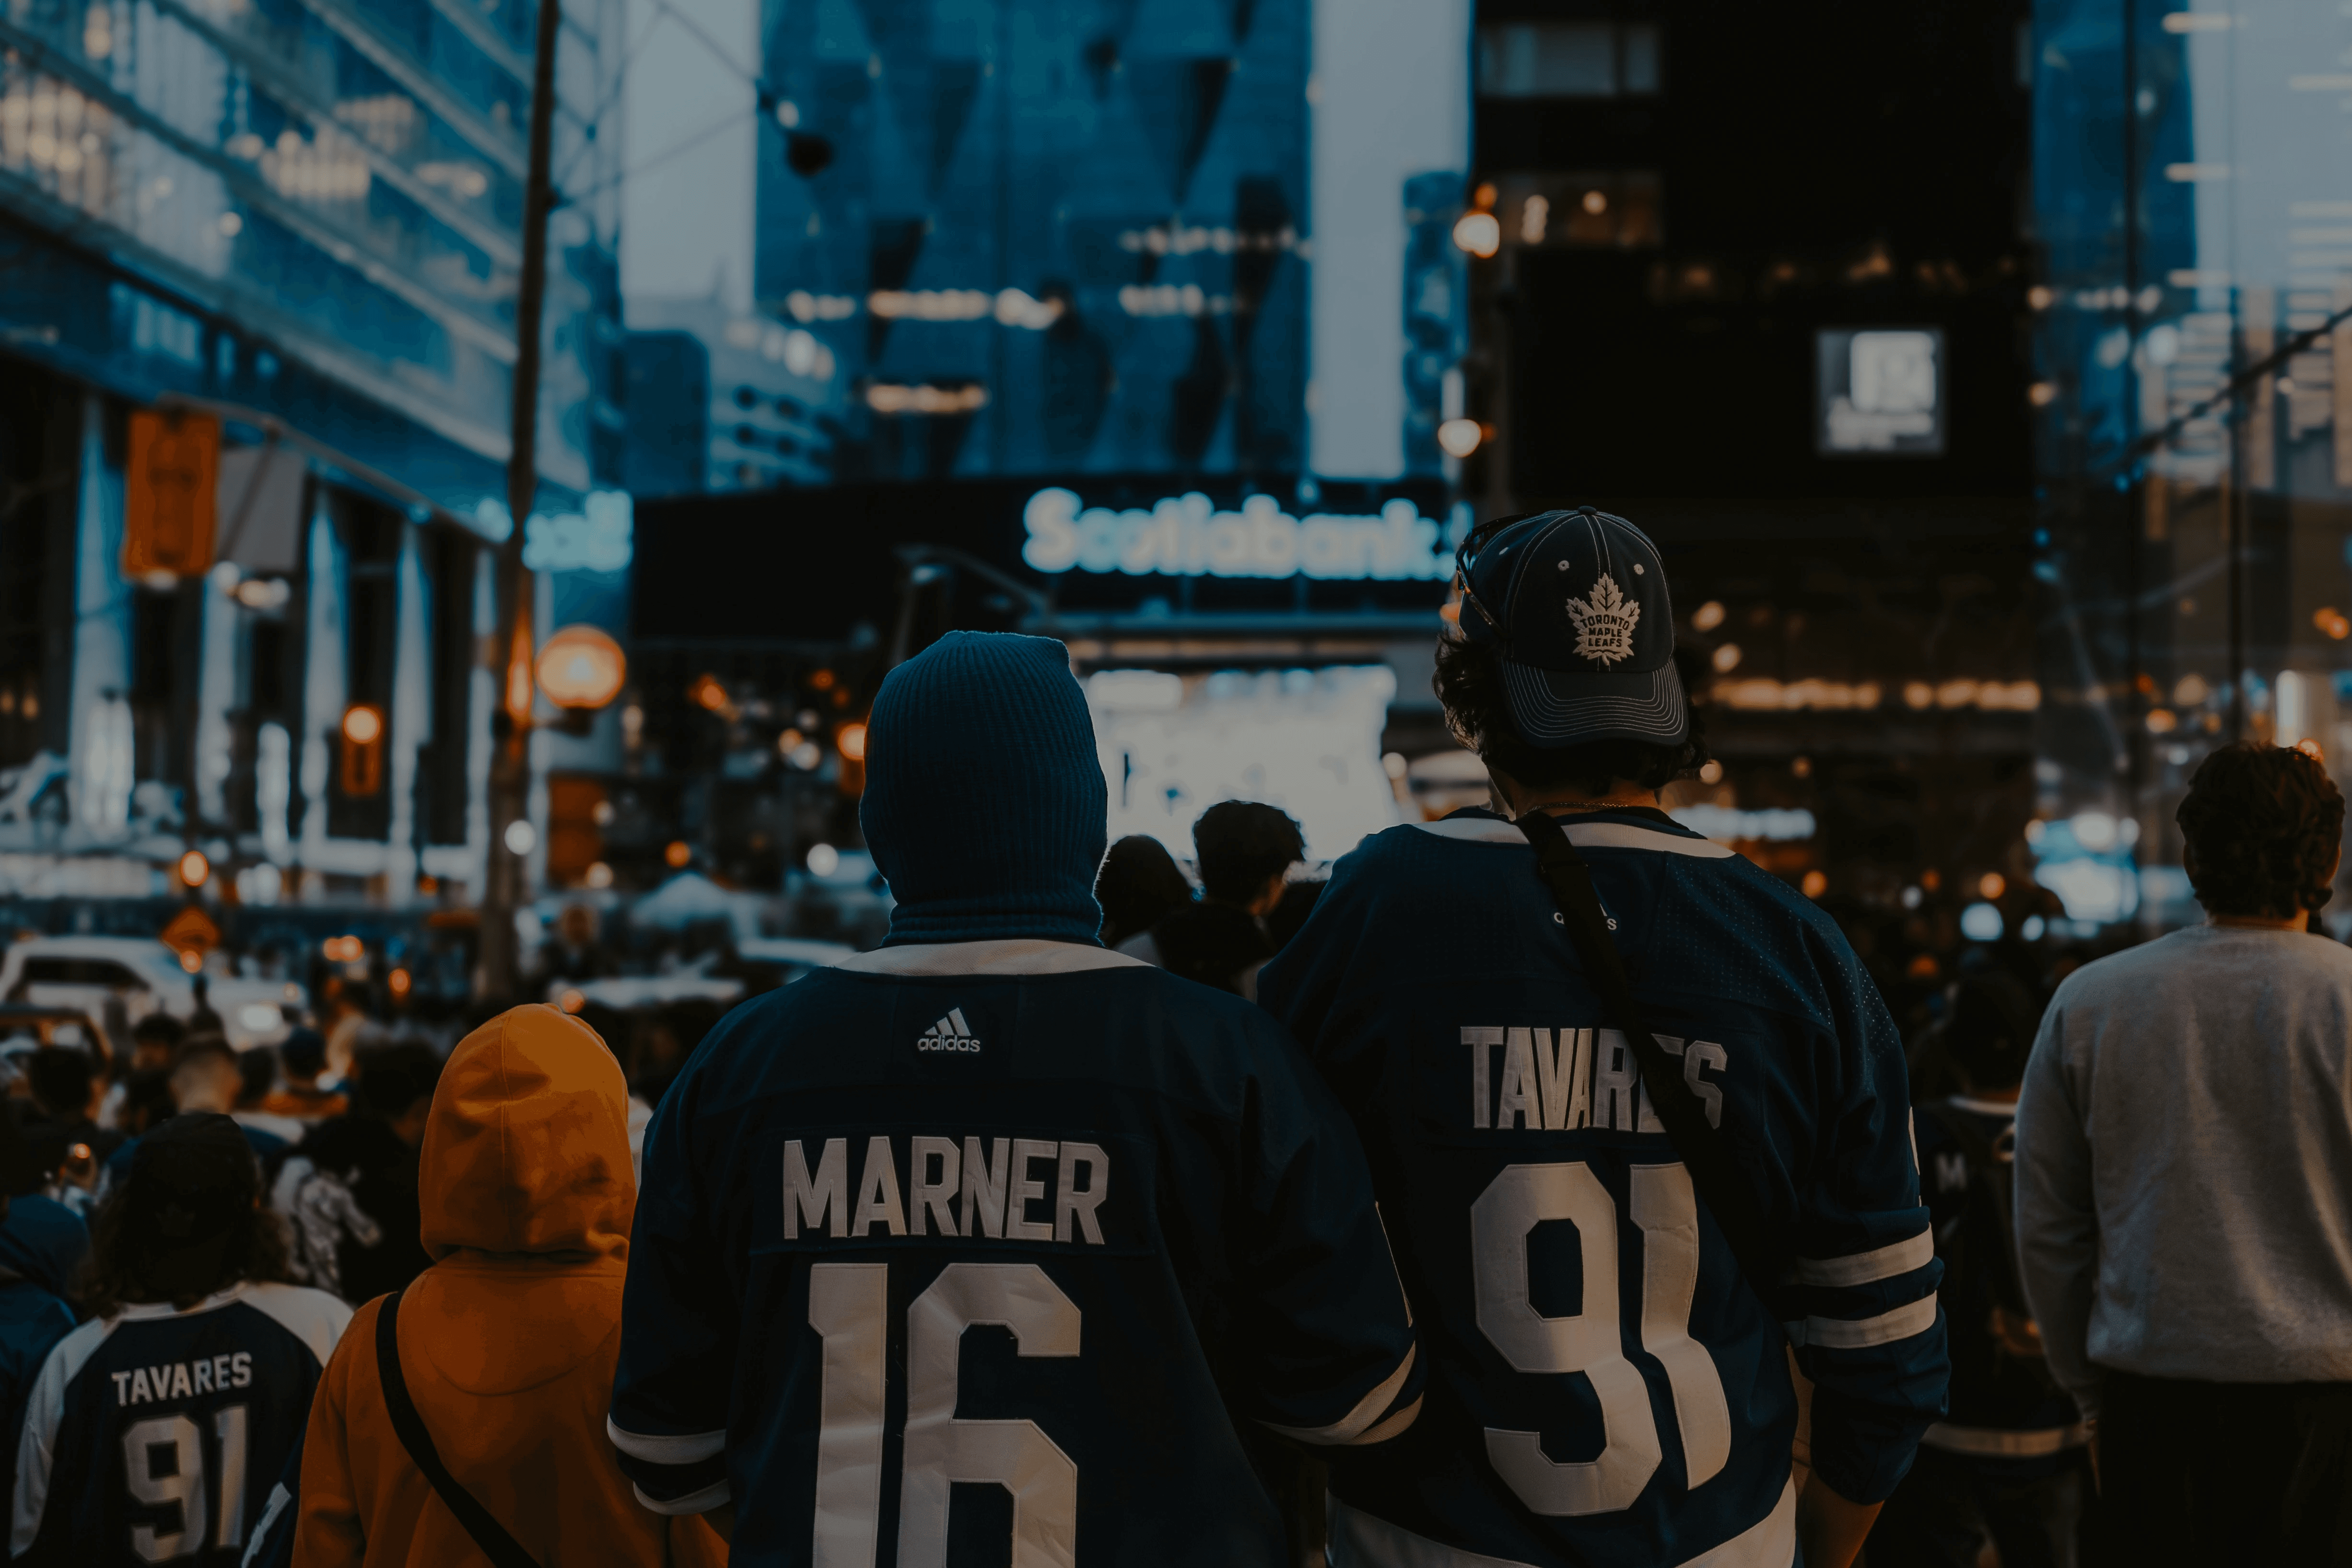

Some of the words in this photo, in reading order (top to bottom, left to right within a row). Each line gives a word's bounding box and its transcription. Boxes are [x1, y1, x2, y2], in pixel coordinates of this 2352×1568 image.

[1022, 487, 1438, 579] Scotiabank
[1580, 614, 1629, 631] TORONTO
[1588, 638, 1622, 647] LEAFS
[1589, 628, 1622, 637] MAPLE
[917, 1034, 981, 1053] adidas
[783, 1135, 1110, 1245] MARNER
[1470, 1161, 1732, 1518] 91
[111, 1351, 253, 1407] TAVARES
[808, 1263, 1082, 1568] 16
[121, 1404, 249, 1564] 91
